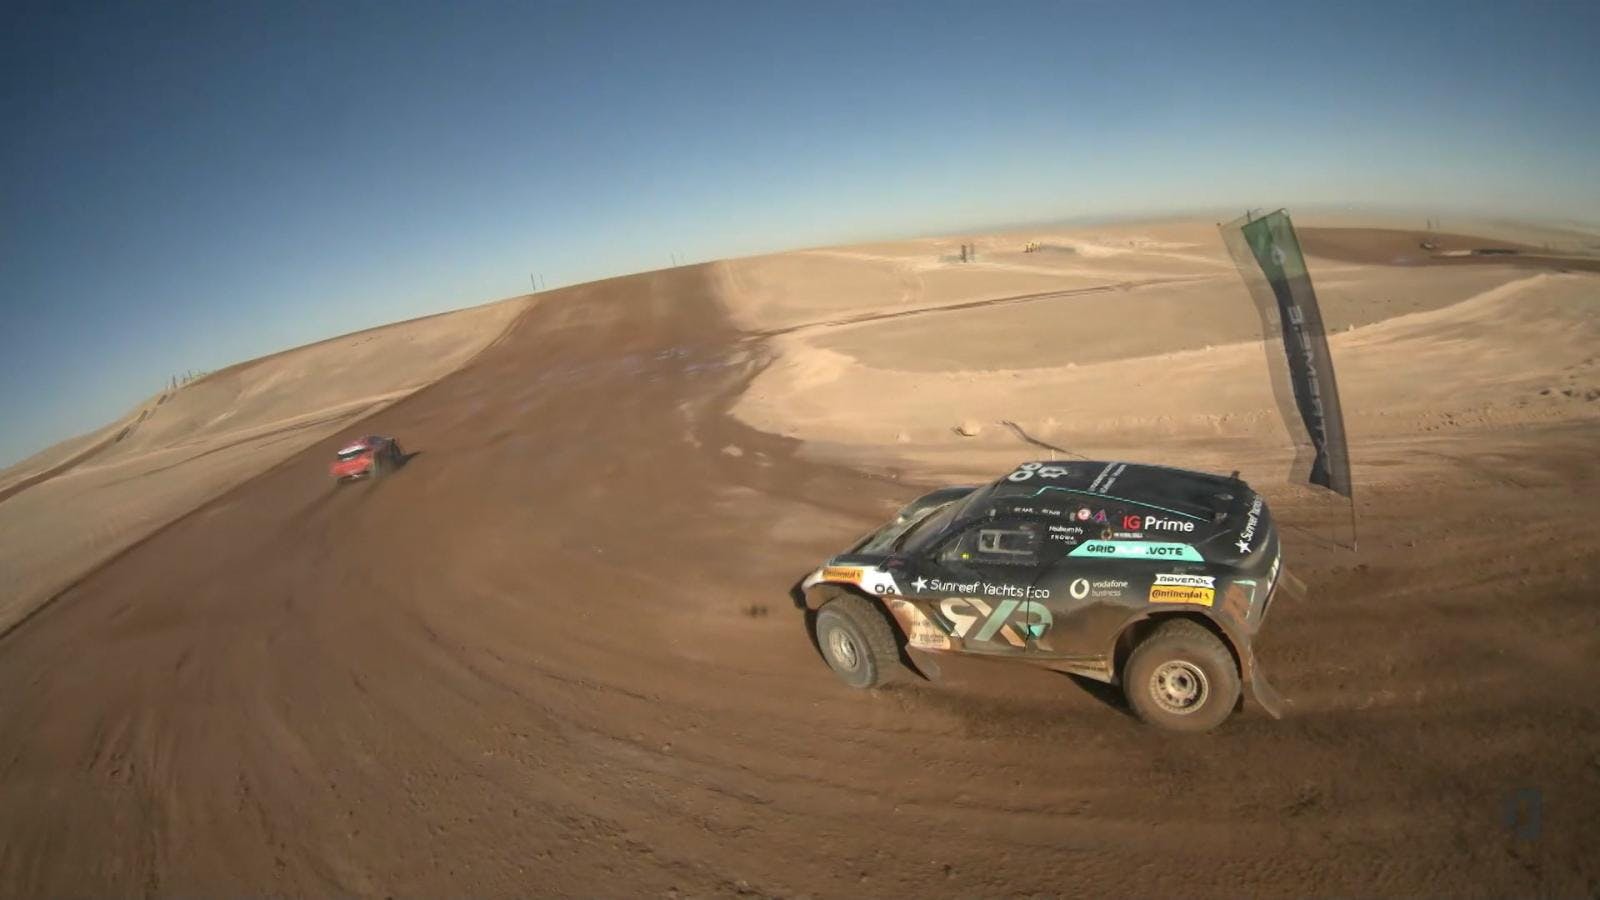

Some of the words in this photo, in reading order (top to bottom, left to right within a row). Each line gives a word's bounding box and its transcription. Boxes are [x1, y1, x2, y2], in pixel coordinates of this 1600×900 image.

[1122, 515, 1141, 530] IG
[1144, 515, 1195, 532] Prime
[874, 583, 896, 594] 06
[930, 579, 980, 593] Sunreef
[982, 582, 1024, 598] Yachts
[1026, 586, 1050, 599] Eco
[1092, 579, 1129, 589] vodafone
[1151, 588, 1202, 599] Continental
